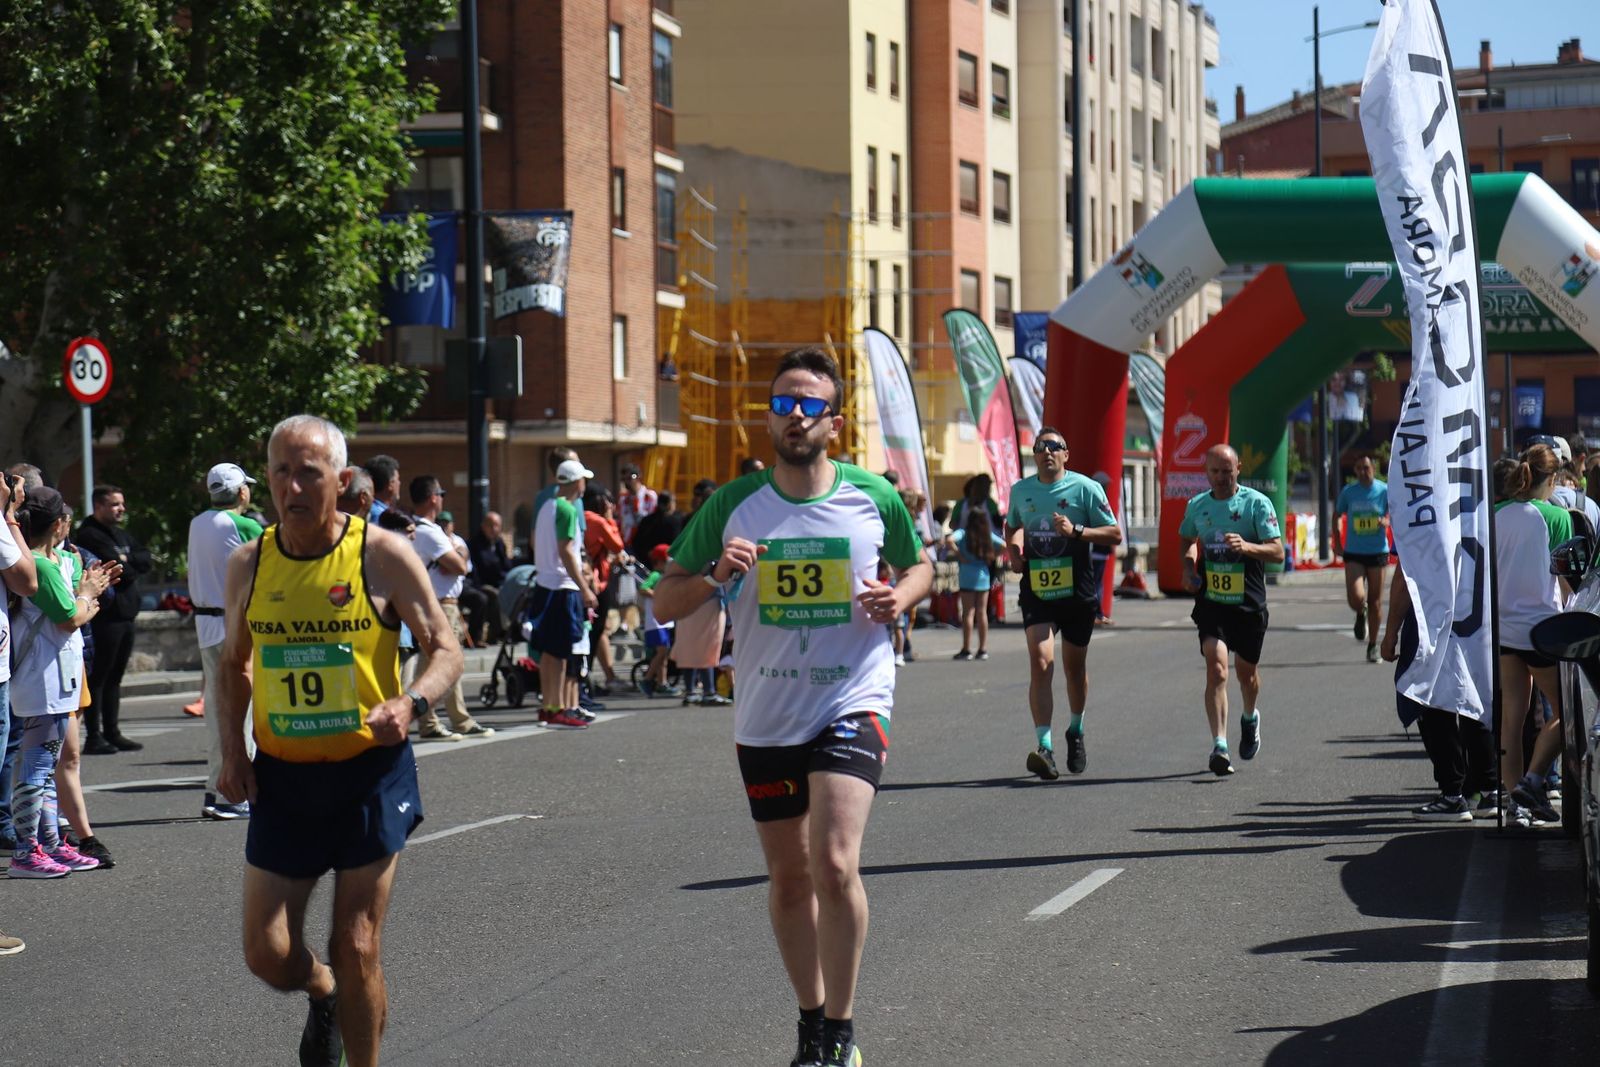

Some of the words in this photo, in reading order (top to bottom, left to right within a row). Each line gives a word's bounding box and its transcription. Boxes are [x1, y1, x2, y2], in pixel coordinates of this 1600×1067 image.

[75, 360, 103, 379] 30
[777, 564, 823, 597] 53
[1039, 570, 1062, 587] 92
[1212, 574, 1232, 591] 88
[786, 609, 810, 619] CAJA
[813, 607, 847, 619] RURAL
[291, 618, 371, 634] VALORIO
[281, 671, 324, 708] 19
[292, 719, 316, 731] CAJA
[320, 716, 357, 730] RURAL
